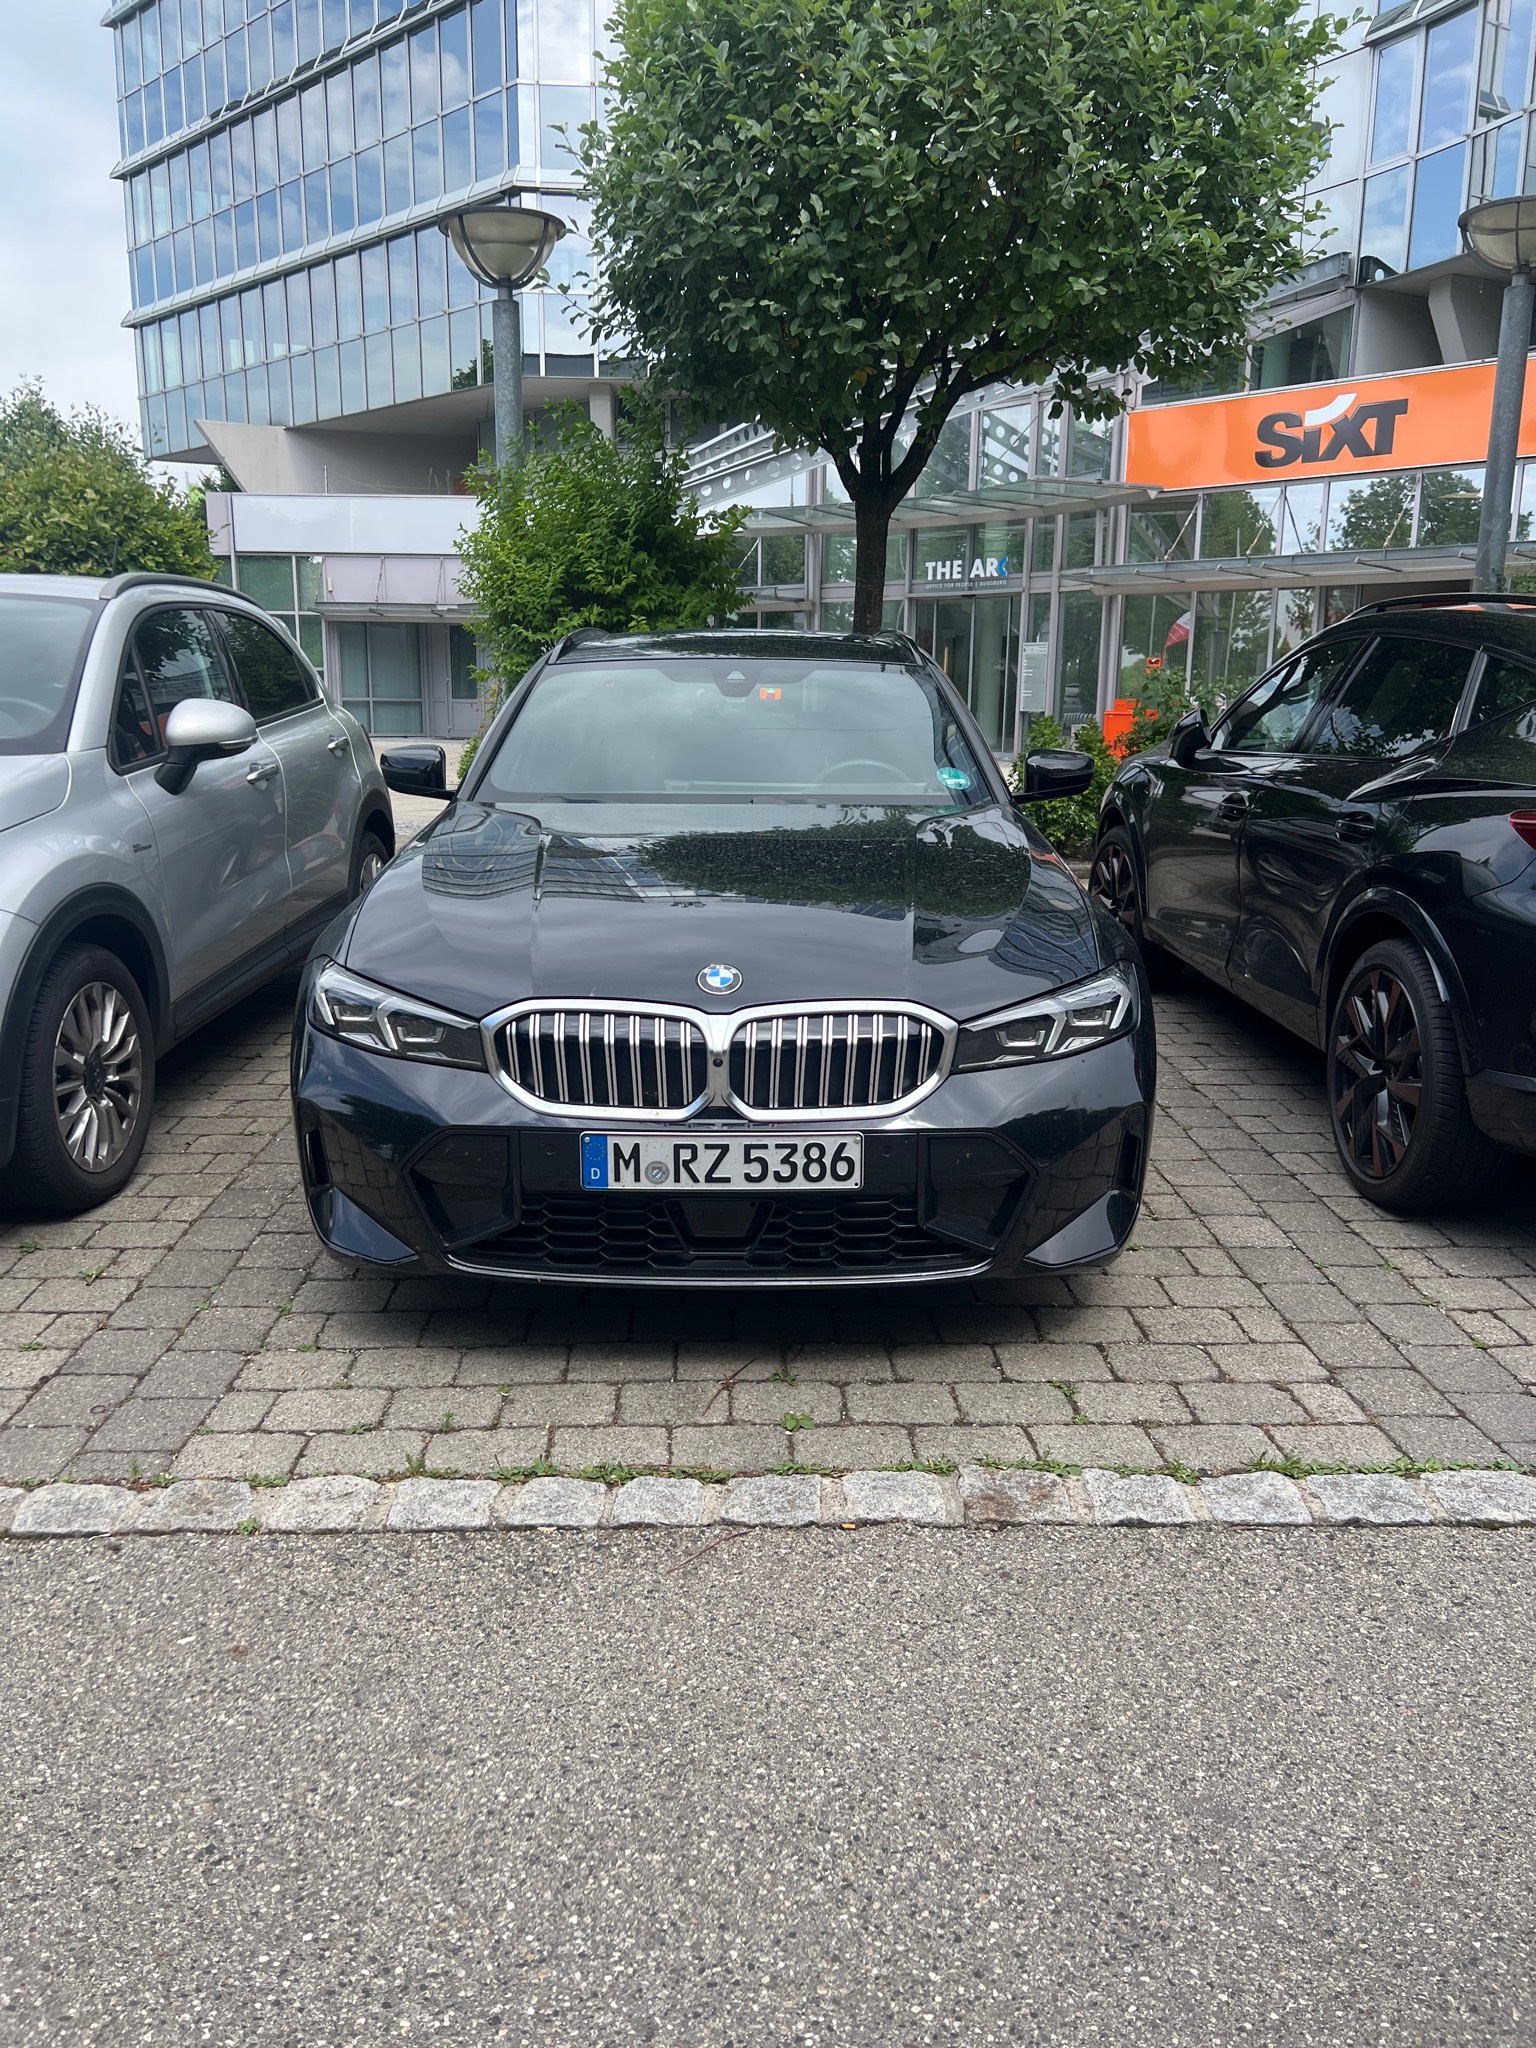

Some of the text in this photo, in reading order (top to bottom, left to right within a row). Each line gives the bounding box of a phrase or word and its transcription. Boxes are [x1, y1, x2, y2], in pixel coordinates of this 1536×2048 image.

[925, 560, 962, 580] THE
[613, 1141, 855, 1183] M RZ 5386
[591, 1167, 600, 1179] D
